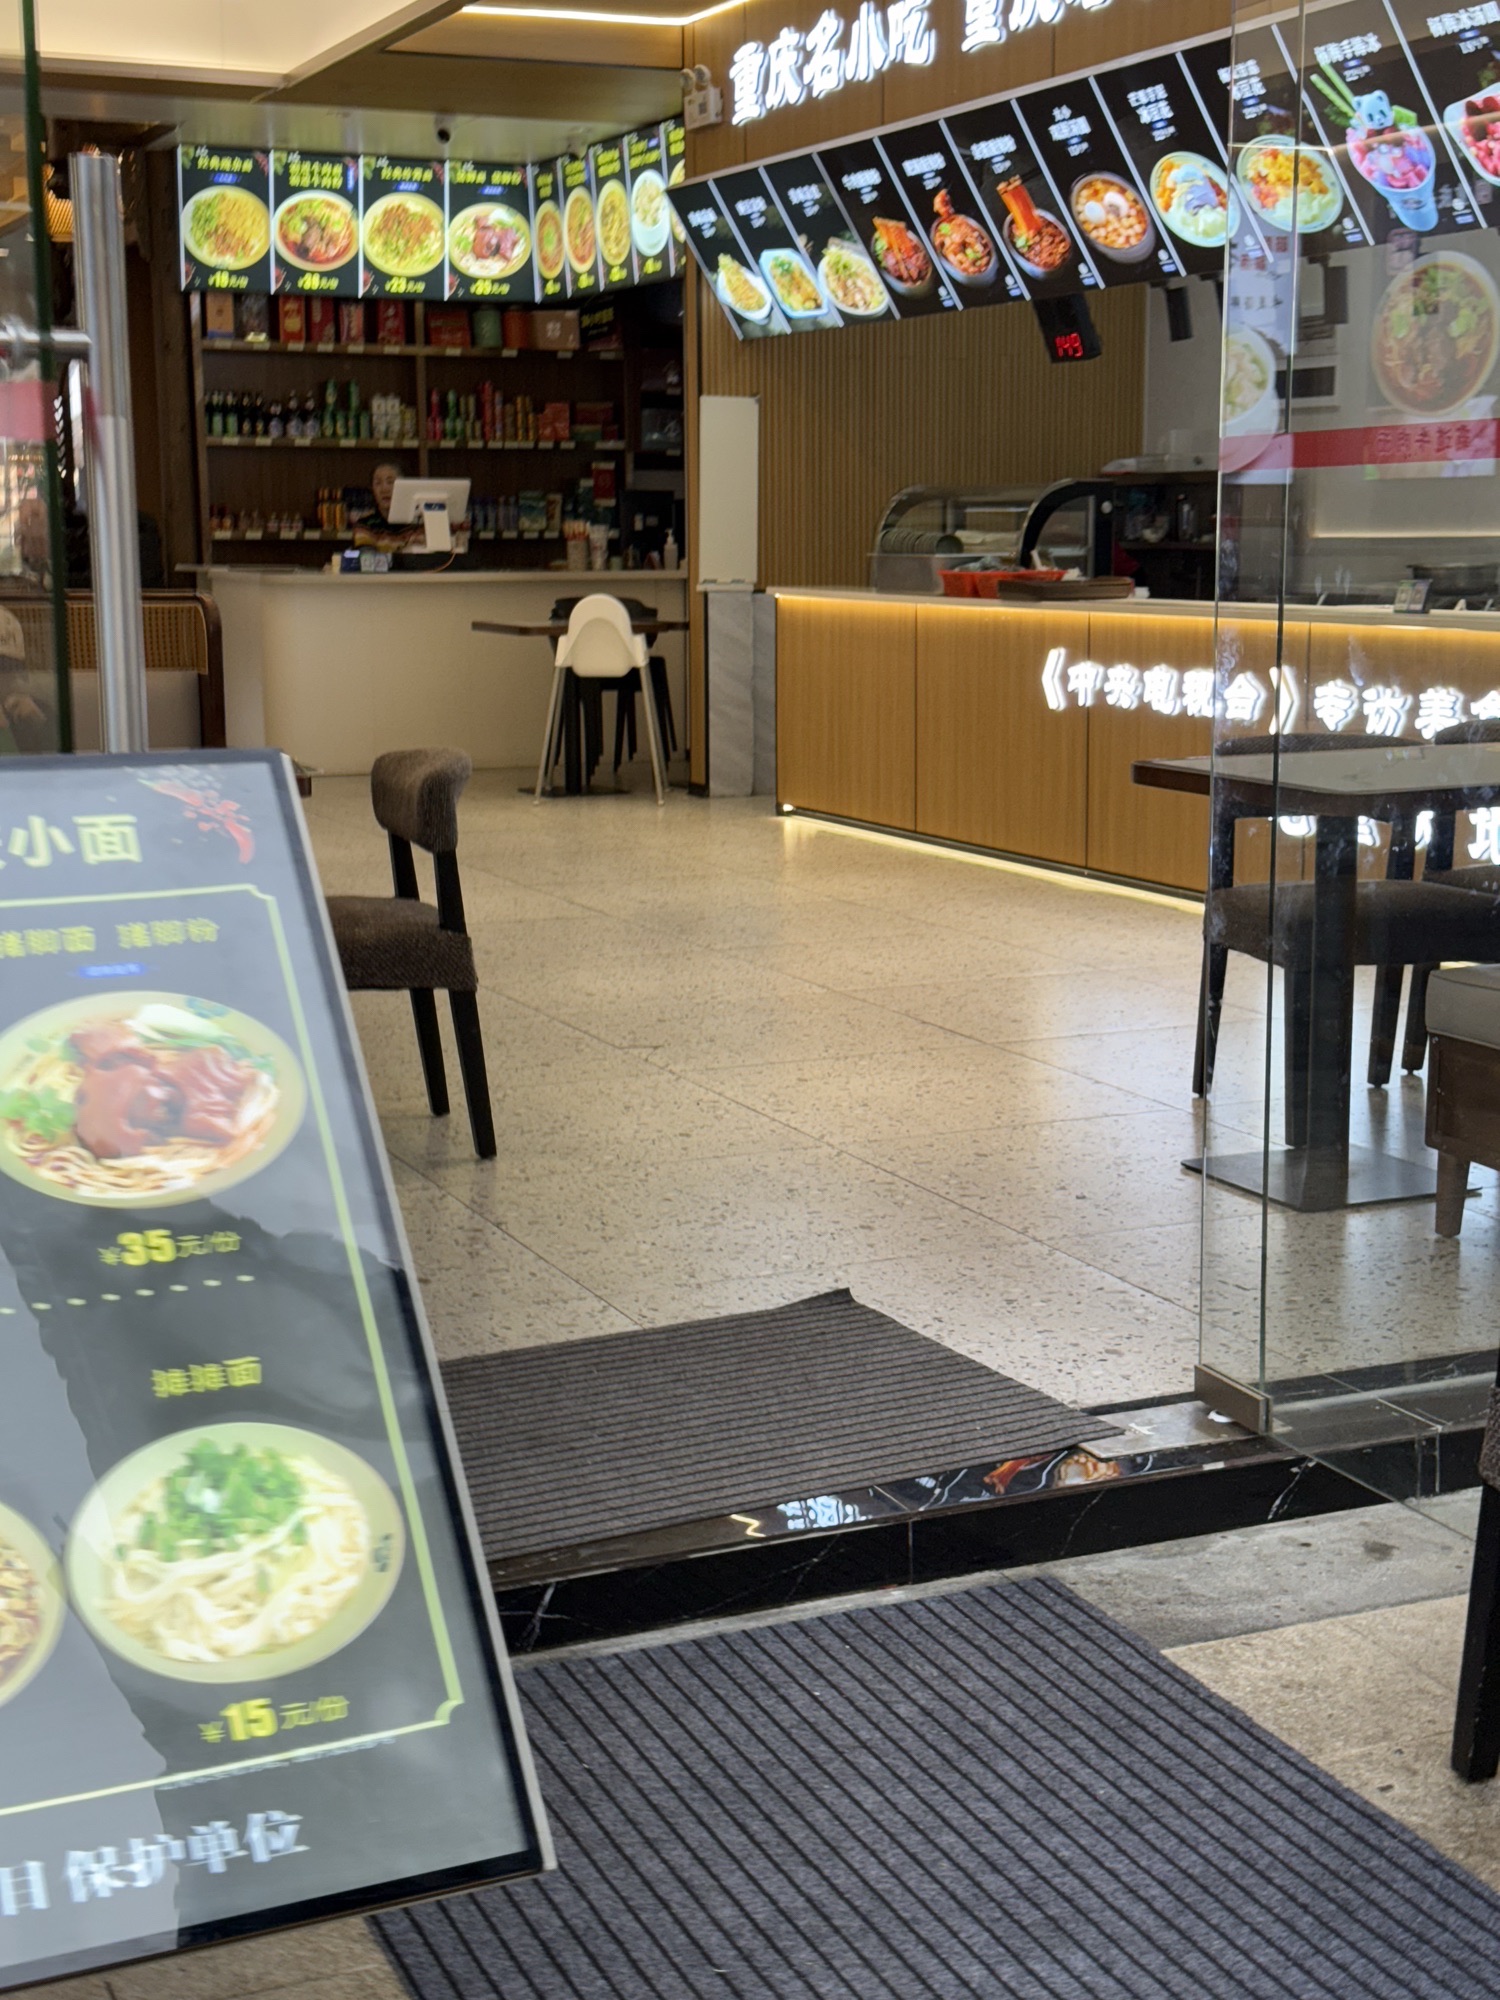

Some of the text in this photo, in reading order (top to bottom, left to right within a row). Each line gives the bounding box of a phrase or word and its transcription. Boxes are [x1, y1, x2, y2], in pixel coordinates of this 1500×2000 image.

[730, 0, 936, 126] 重庆名小吃
[0, 815, 143, 869] 小面
